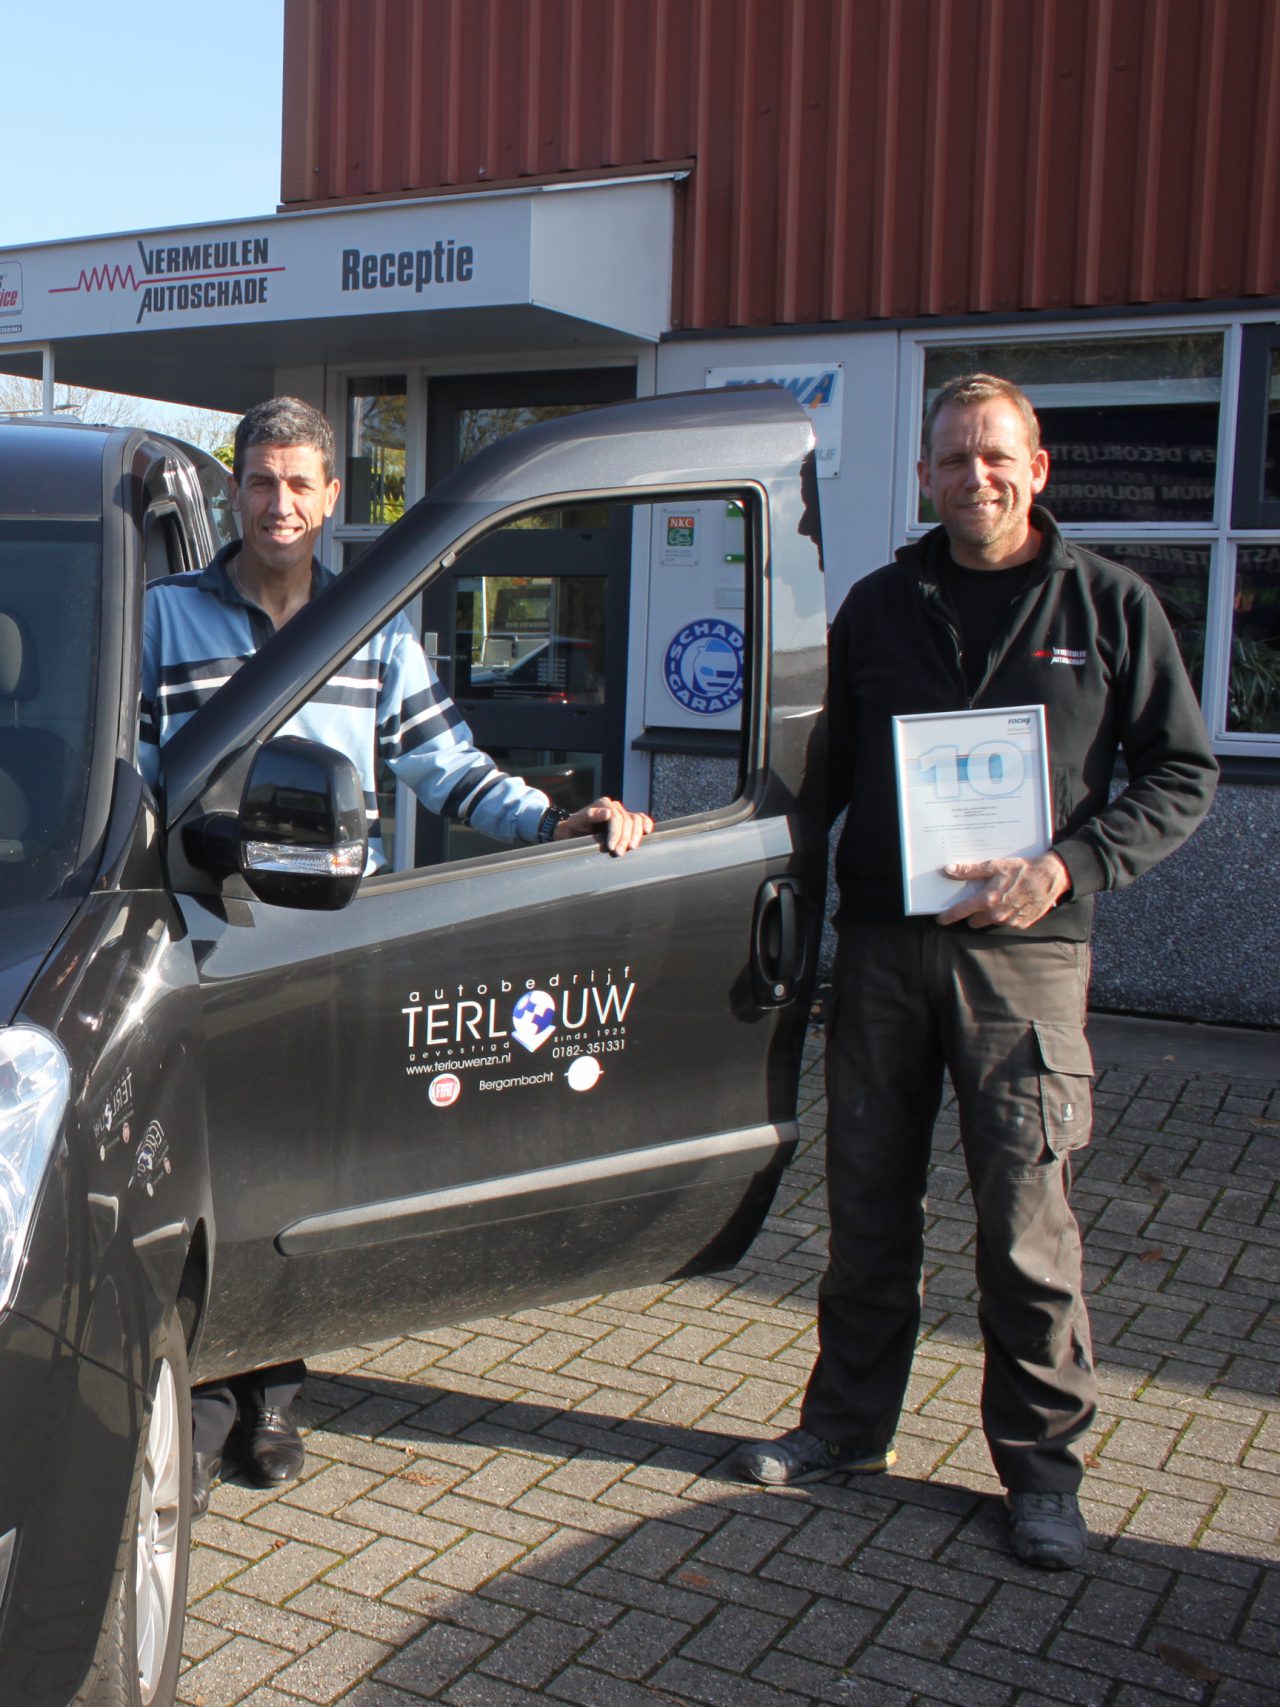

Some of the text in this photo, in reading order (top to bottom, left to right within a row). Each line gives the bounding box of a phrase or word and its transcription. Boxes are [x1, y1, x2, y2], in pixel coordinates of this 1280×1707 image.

[137, 238, 269, 275] VERMEULEN
[341, 239, 473, 293] Receptie
[136, 277, 268, 324] AUTOSCHADE
[670, 518, 694, 528] NKC
[919, 740, 1025, 799] 10
[409, 965, 631, 1002] autobedrijf
[409, 1027, 626, 1062] gevestigd sinds 1925
[586, 1038, 626, 1055] 351331
[406, 1052, 512, 1076] www.terlouwenzn.nl
[479, 1071, 554, 1091] Bergambacht
